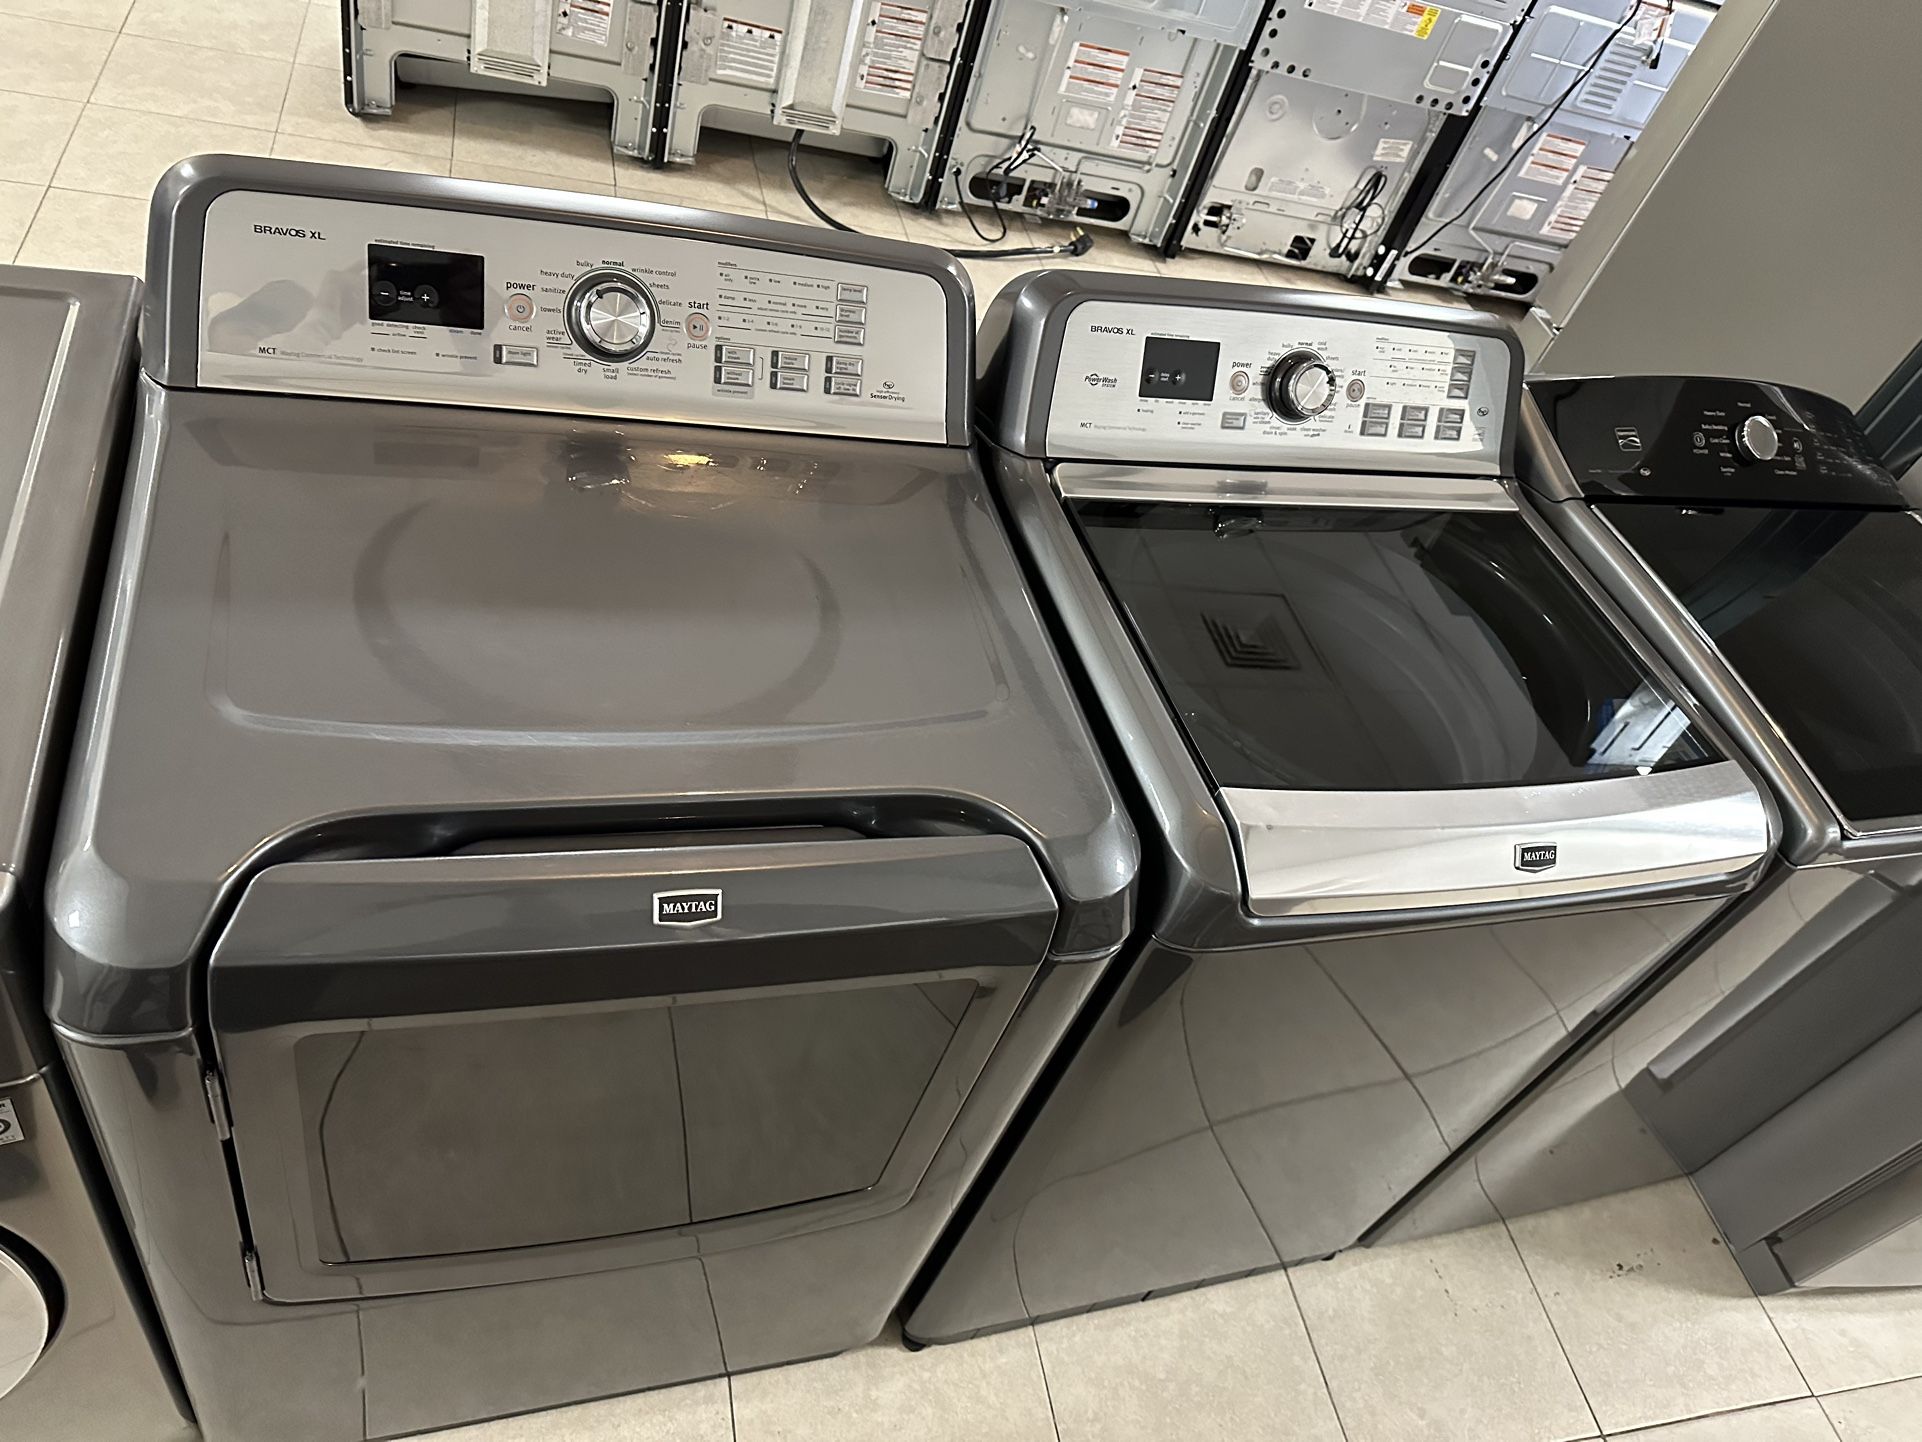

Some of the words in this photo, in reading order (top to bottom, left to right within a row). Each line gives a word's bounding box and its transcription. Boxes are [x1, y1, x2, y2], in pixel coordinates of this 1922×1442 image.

[254, 224, 306, 238] BRAVOS
[309, 230, 326, 241] XL
[576, 260, 594, 268] bulky
[540, 269, 559, 278] heavy
[560, 272, 575, 280] duty
[631, 267, 654, 275] wrinkle
[505, 281, 536, 292] power
[649, 282, 670, 290] sheets
[658, 299, 682, 307] delicate
[687, 300, 710, 310] start
[540, 306, 562, 314] towels
[661, 318, 681, 326] denim
[508, 324, 533, 332] cancel
[1090, 325, 1124, 335] BRAVOS
[1126, 328, 1136, 336] XL
[687, 342, 708, 350] pause
[258, 346, 276, 355] MCT
[661, 356, 682, 364] refresh
[1231, 361, 1252, 369] power
[577, 367, 588, 375] dry
[870, 393, 905, 402] SensorDrying
[1523, 849, 1555, 861] MAYTAG
[662, 900, 715, 915] MAYTAG
